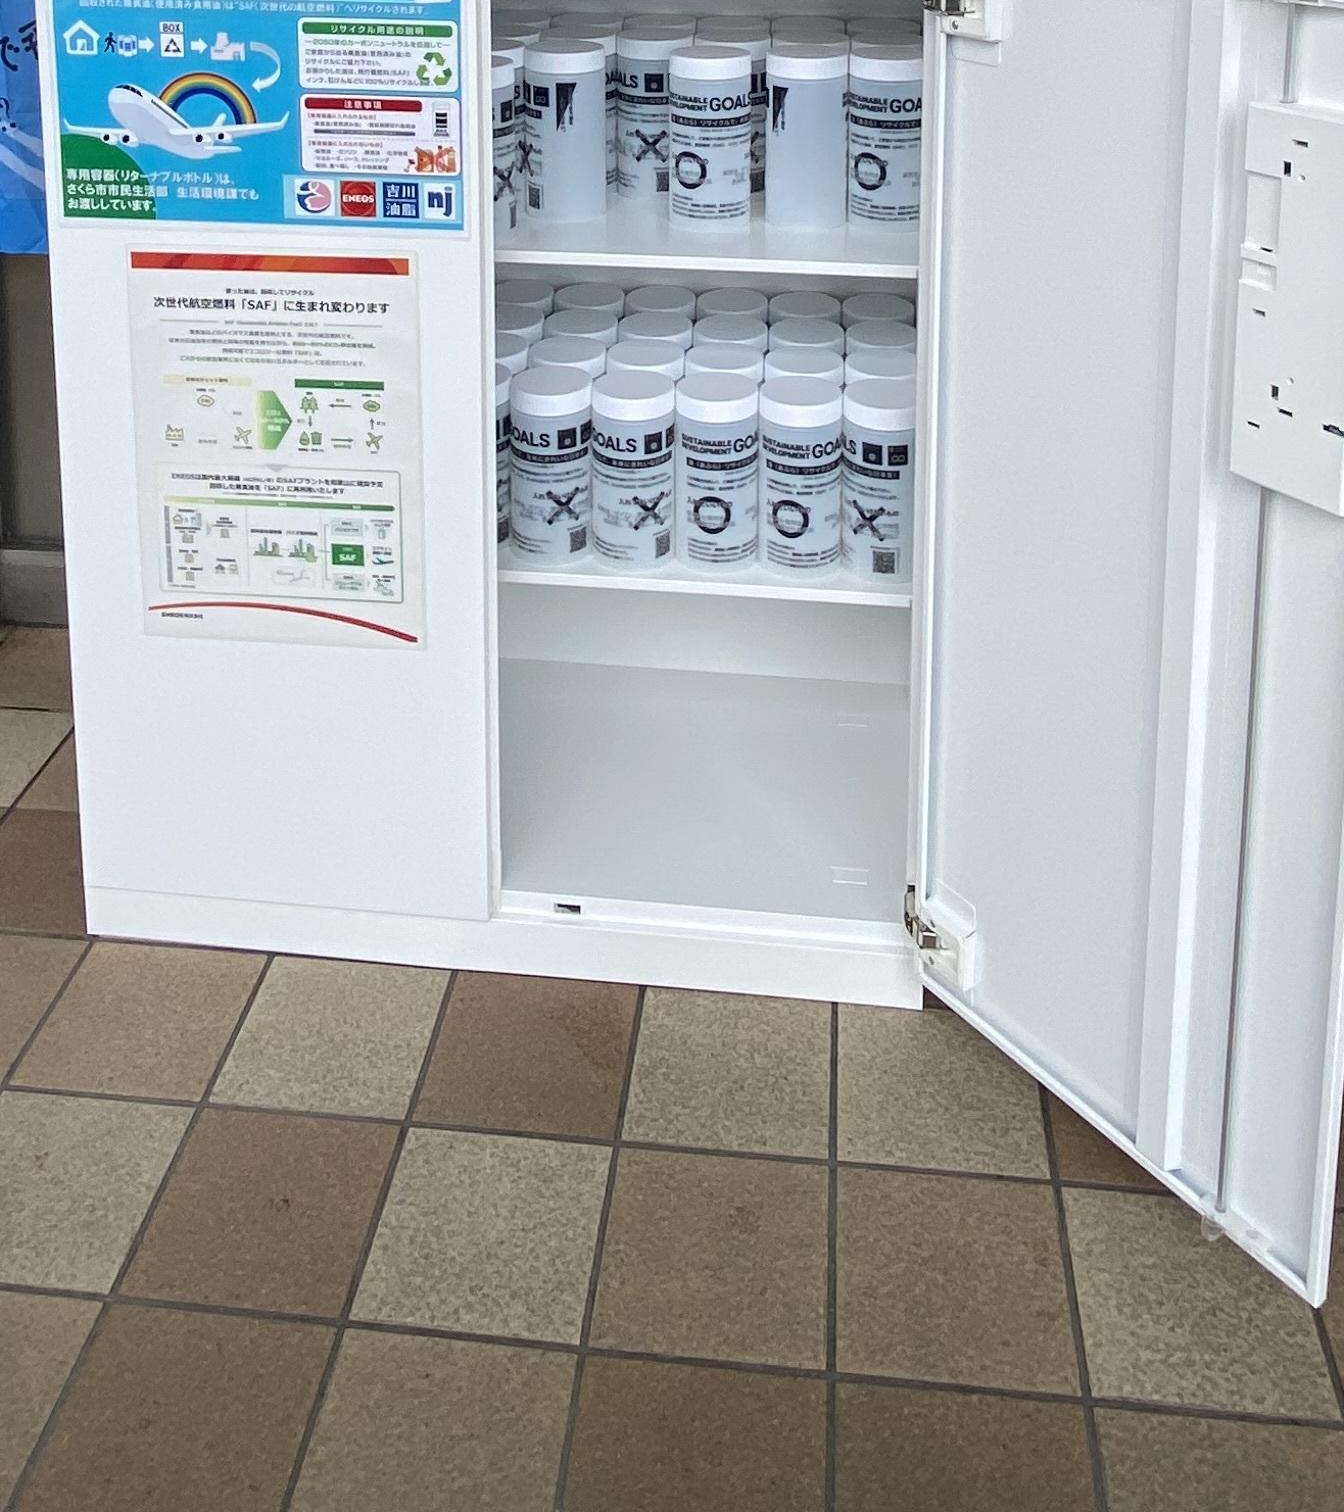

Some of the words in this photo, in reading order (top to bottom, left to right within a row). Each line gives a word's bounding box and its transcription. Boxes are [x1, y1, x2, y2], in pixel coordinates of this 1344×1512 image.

[162, 22, 181, 33] BOX
[67, 197, 157, 212] お渡ししています。
[341, 193, 375, 204] ENEOS
[153, 296, 391, 315] 次世代航空燃料「SAF」に生まれ変わります
